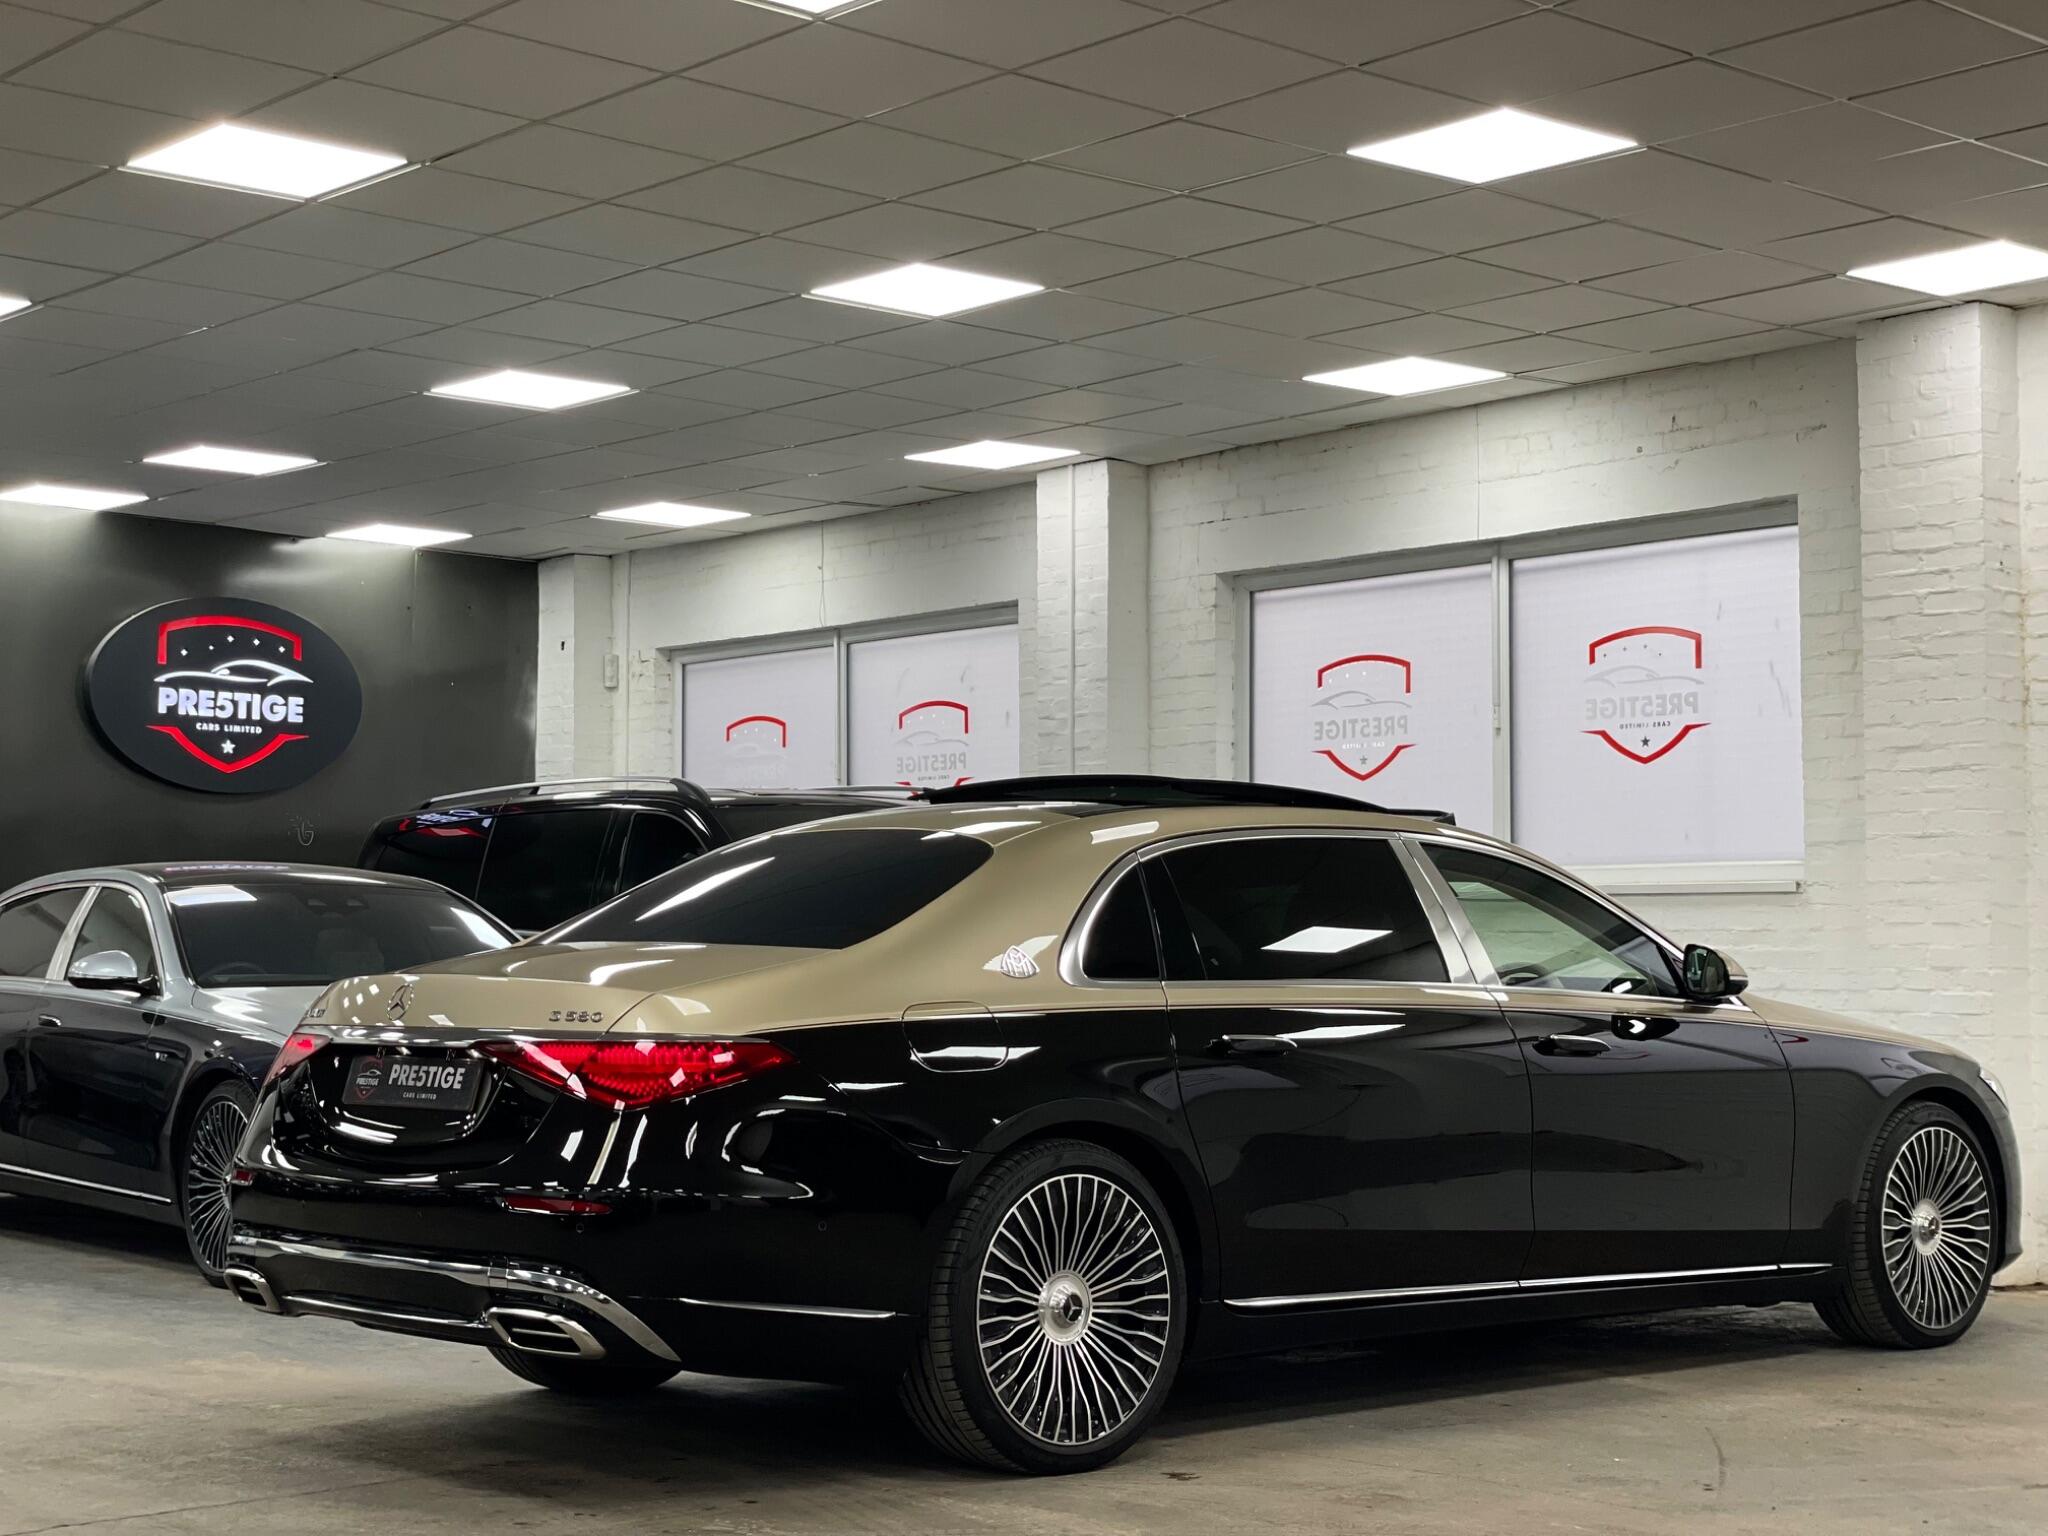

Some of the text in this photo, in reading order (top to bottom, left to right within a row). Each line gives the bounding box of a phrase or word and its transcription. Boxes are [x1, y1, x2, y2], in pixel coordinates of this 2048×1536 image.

[196, 722, 262, 735] CARS LIMITED
[549, 1010, 603, 1023] S 580
